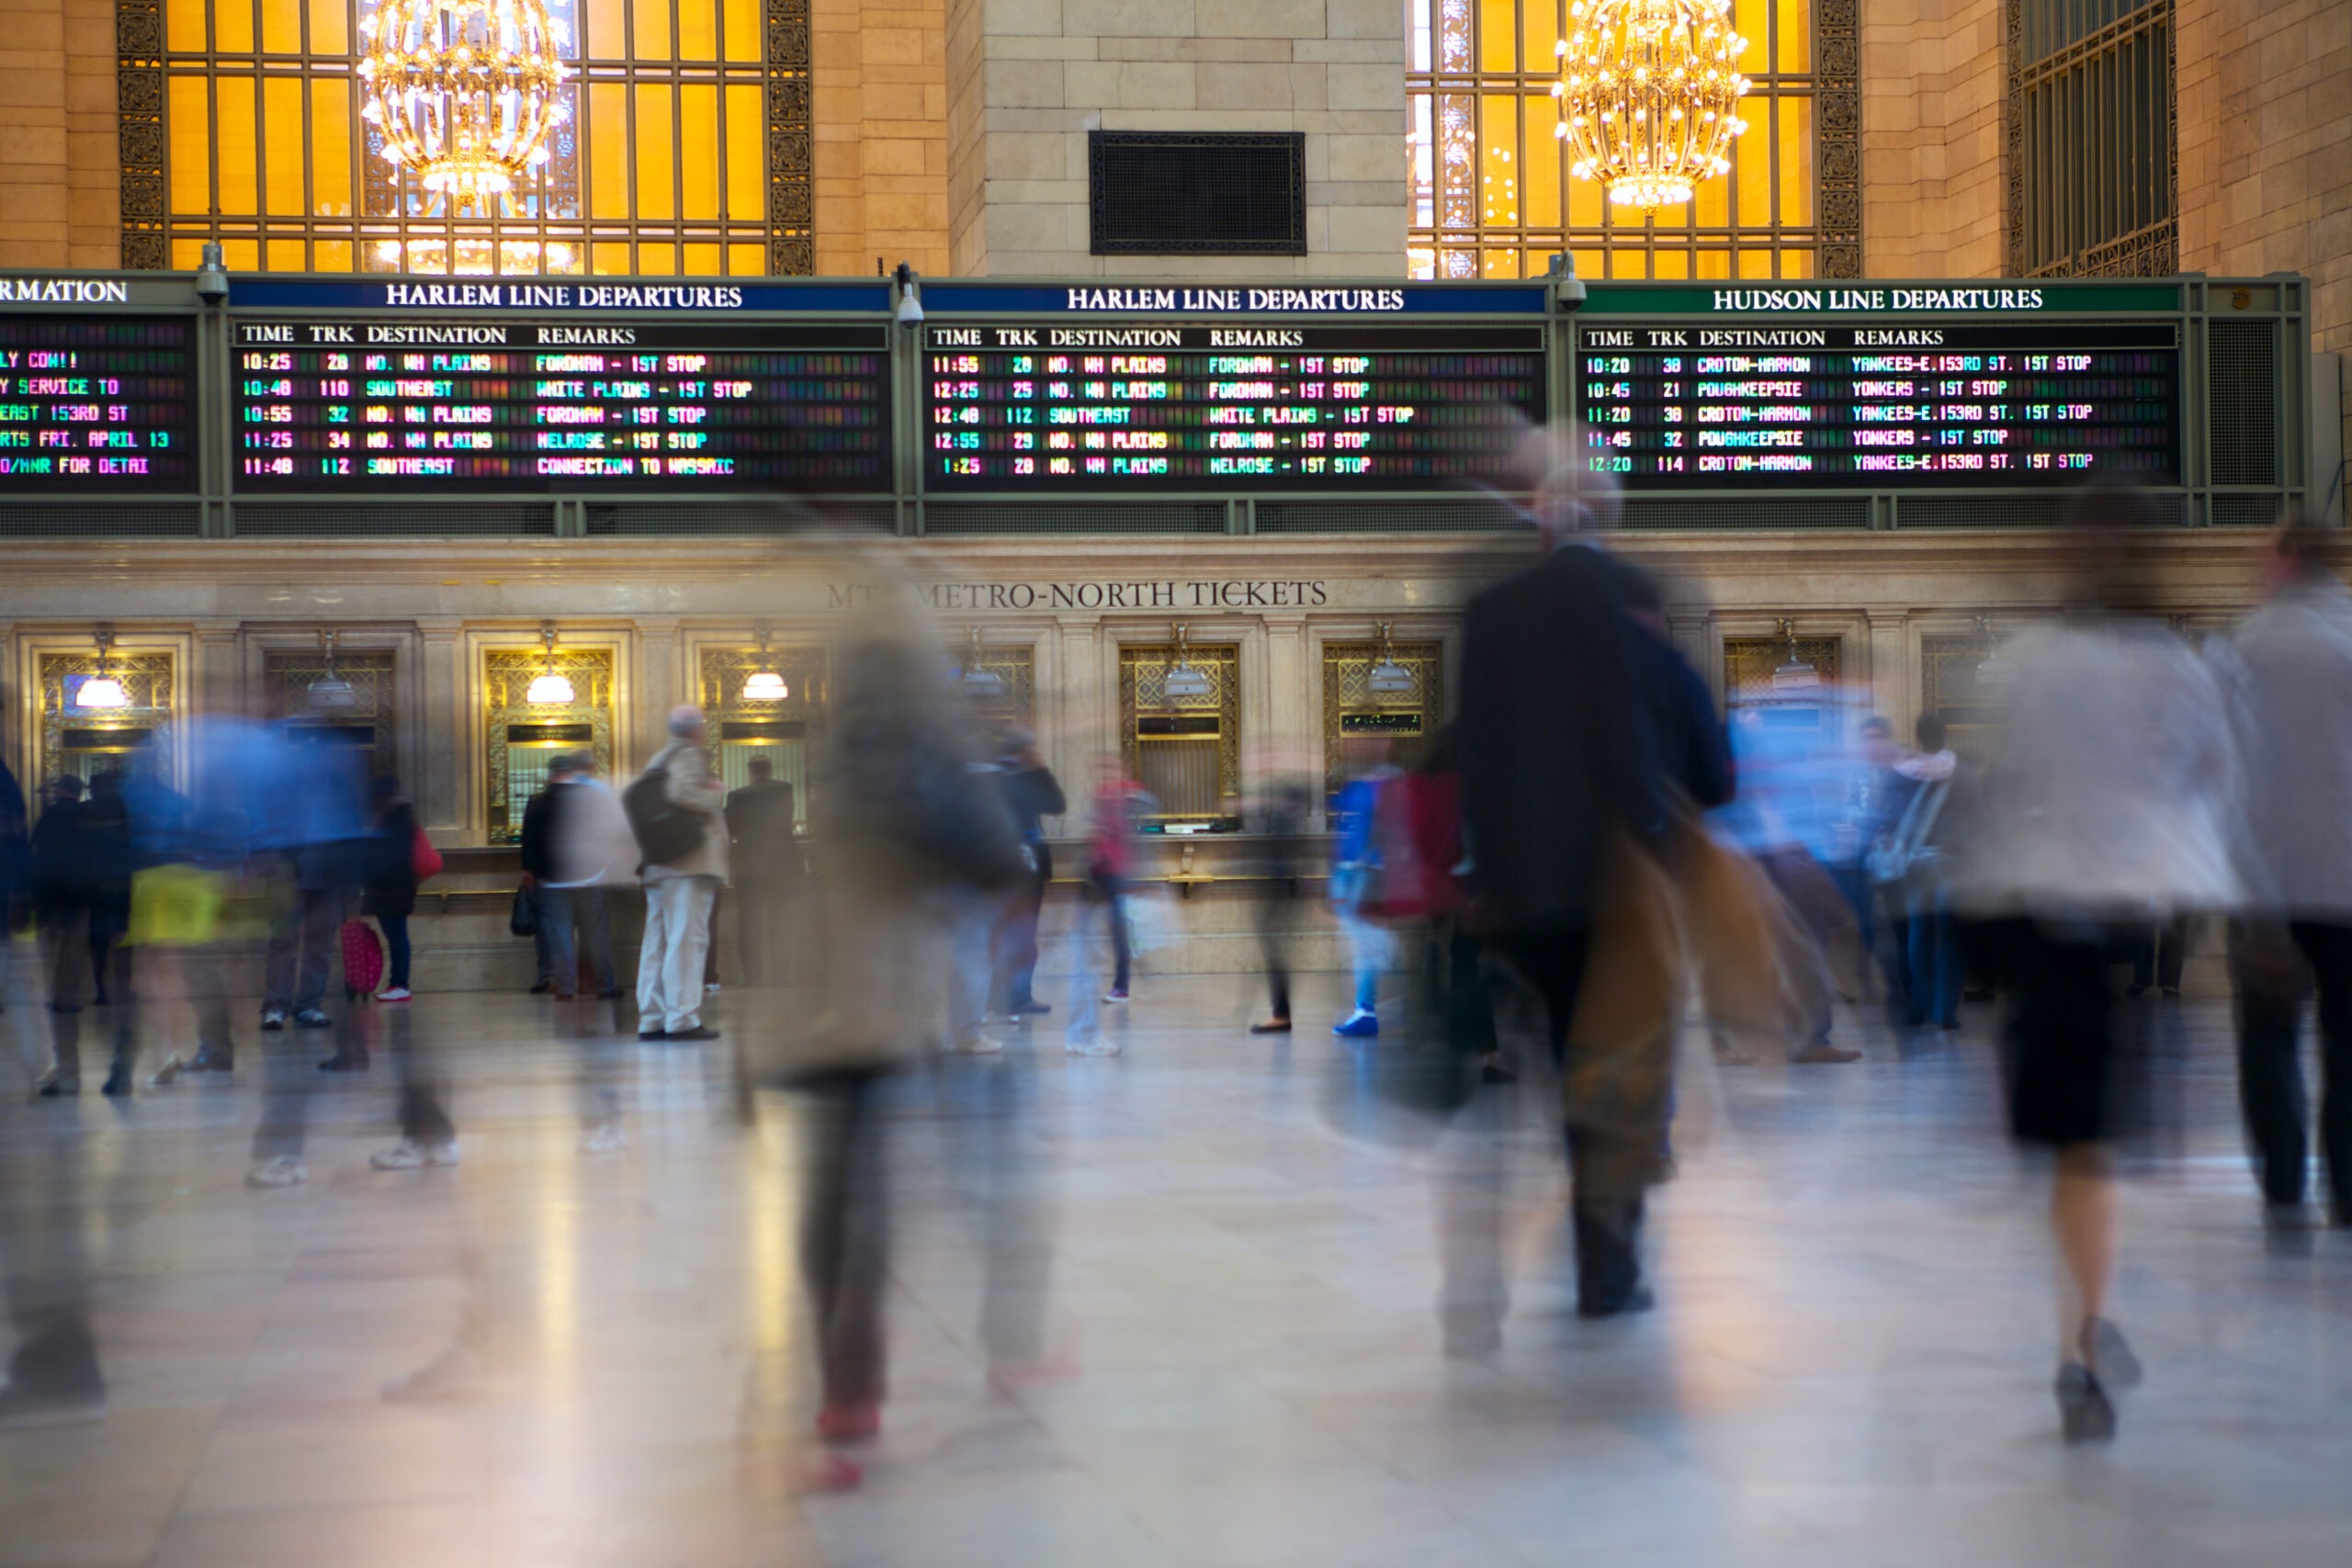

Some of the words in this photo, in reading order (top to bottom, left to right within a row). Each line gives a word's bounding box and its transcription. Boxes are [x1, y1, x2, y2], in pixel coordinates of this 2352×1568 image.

[0, 280, 126, 301] RMATION
[387, 285, 501, 305] HARLEM
[510, 286, 570, 306] LINE
[579, 287, 741, 307] DEPARTURES
[1069, 289, 1175, 309] HARLEM
[1183, 289, 1240, 310] LINE
[1249, 289, 1404, 310] DEPARTURES
[1714, 290, 1821, 310] HUDSON
[1829, 290, 1884, 309] LINE
[1893, 289, 2042, 309] DEPARTURES
[243, 326, 293, 341] TIME
[310, 327, 354, 342] TRK
[368, 327, 505, 343] DESTINATION
[538, 328, 635, 344] REMARKS
[934, 330, 981, 344] TIME
[997, 330, 1037, 344] TRK
[1051, 330, 1180, 345] DESTINATION
[1211, 331, 1303, 345] REMARKS
[1588, 332, 1633, 345] TIME
[1648, 332, 1687, 345] TRK
[1701, 331, 1825, 345] DESTINATION
[1855, 331, 1943, 344] REMARKS
[243, 353, 291, 369] 10:25
[403, 355, 425, 370] WH
[433, 355, 492, 371] PLAINS
[537, 355, 605, 372] FORDHAM
[632, 355, 658, 372] 1ST
[667, 355, 707, 372] STOP
[934, 356, 978, 373] 11:55
[1084, 356, 1104, 373] WH
[1112, 356, 1166, 373] PLAINS
[1209, 356, 1273, 373] FORDHAM
[1299, 357, 1324, 373] 1ST
[1333, 357, 1369, 373] STOP
[1588, 358, 1629, 373] 10:20
[1664, 358, 1680, 373] 38
[1698, 357, 1810, 373] CROTON-HARMON
[1989, 356, 2012, 370] ST.
[2025, 356, 2048, 370] 1ST
[2057, 355, 2091, 370] STOP
[19, 378, 88, 394] SERVICE
[99, 379, 119, 394] TO
[244, 379, 292, 396] 10:48
[321, 379, 349, 396] 110
[367, 379, 453, 397] SOUTHEAST
[537, 380, 584, 397] WHITE
[594, 381, 650, 398] PLAINS
[679, 381, 705, 398] 1ST
[713, 381, 752, 398] STOP
[934, 381, 978, 398] 12:25
[1013, 381, 1032, 398] 25
[1085, 382, 1105, 398] WH
[1113, 381, 1168, 399] PLAINS
[1209, 381, 1273, 399] FORDHAM
[1300, 382, 1325, 398] 1ST
[1333, 382, 1369, 398] STOP
[1589, 383, 1630, 398] 10:45
[1664, 382, 1679, 397] 21
[1698, 381, 1802, 397] POUGHKEEPSIE
[1853, 381, 1913, 396] YONKERS
[1940, 381, 1963, 395] 1ST
[1973, 380, 2007, 395] STOP
[0, 405, 38, 420] EAST
[51, 405, 98, 421] 153RD
[108, 406, 128, 421] ST
[245, 405, 292, 422] 10:55
[329, 406, 348, 422] 32
[404, 406, 425, 422] WH
[434, 406, 492, 423] PLAINS
[537, 406, 605, 423] FORDHAM
[633, 407, 659, 423] 1ST
[668, 407, 706, 423] STOP
[935, 407, 978, 423] 12:48
[1007, 408, 1032, 423] 112
[1050, 407, 1130, 423] SOUTHEAST
[1210, 407, 1255, 423] WHITE
[1263, 407, 1317, 423] PLAINS
[1345, 406, 1369, 423] 1ST
[1377, 406, 1413, 423] STOP
[1589, 407, 1630, 422] 11:20
[1665, 407, 1682, 422] 38
[1699, 406, 1811, 422] CROTON-HARMON
[1990, 405, 2013, 420] ST.
[2026, 405, 2049, 419] 1ST
[2058, 405, 2092, 419] STOP
[89, 431, 138, 447] APRIL
[151, 433, 168, 446] 13
[245, 432, 292, 447] 11:25
[329, 432, 350, 447] 34
[405, 432, 426, 448] WH
[434, 432, 492, 448] PLAINS
[537, 433, 605, 448] MELROSE
[633, 433, 660, 448] 1ST
[668, 432, 707, 448] STOP
[935, 433, 979, 448] 12:55
[1014, 432, 1033, 448] 29
[1086, 432, 1107, 448] WH
[1112, 432, 1168, 448] PLAINS
[1210, 432, 1274, 448] FORDHAM
[1301, 432, 1326, 448] 1ST
[1334, 432, 1370, 448] STOP
[1589, 432, 1631, 447] 11:45
[1665, 432, 1682, 446] 32
[1699, 431, 1803, 446] POUGHKEEPSIE
[1853, 430, 1914, 446] YONKERS
[1940, 430, 1964, 445] 1ST
[1973, 430, 2007, 444] STOP
[60, 457, 90, 473] FOR
[99, 457, 148, 473] DETAI
[245, 457, 292, 474] 11:48
[322, 457, 349, 474] 112
[368, 457, 454, 474] SOUTHEAST
[537, 457, 633, 474] CONNECTION
[640, 457, 661, 474] TO
[666, 457, 733, 474] WASSAIC
[944, 457, 980, 474] 1:25
[1086, 457, 1106, 473] WH
[1114, 457, 1167, 473] PLAINS
[1211, 457, 1273, 473] MELROSE
[1302, 457, 1326, 472] 1ST
[1335, 457, 1371, 473] STOP
[1589, 457, 1631, 473] 12:20
[1658, 457, 1683, 471] 114
[1700, 456, 1812, 470] CROTON-HARMON
[1991, 454, 2014, 468] ST.
[2027, 454, 2050, 468] 1ST
[2059, 454, 2093, 468] STOP
[917, 582, 1175, 609] METRO-NORTH
[1186, 581, 1327, 607] TICKETS
